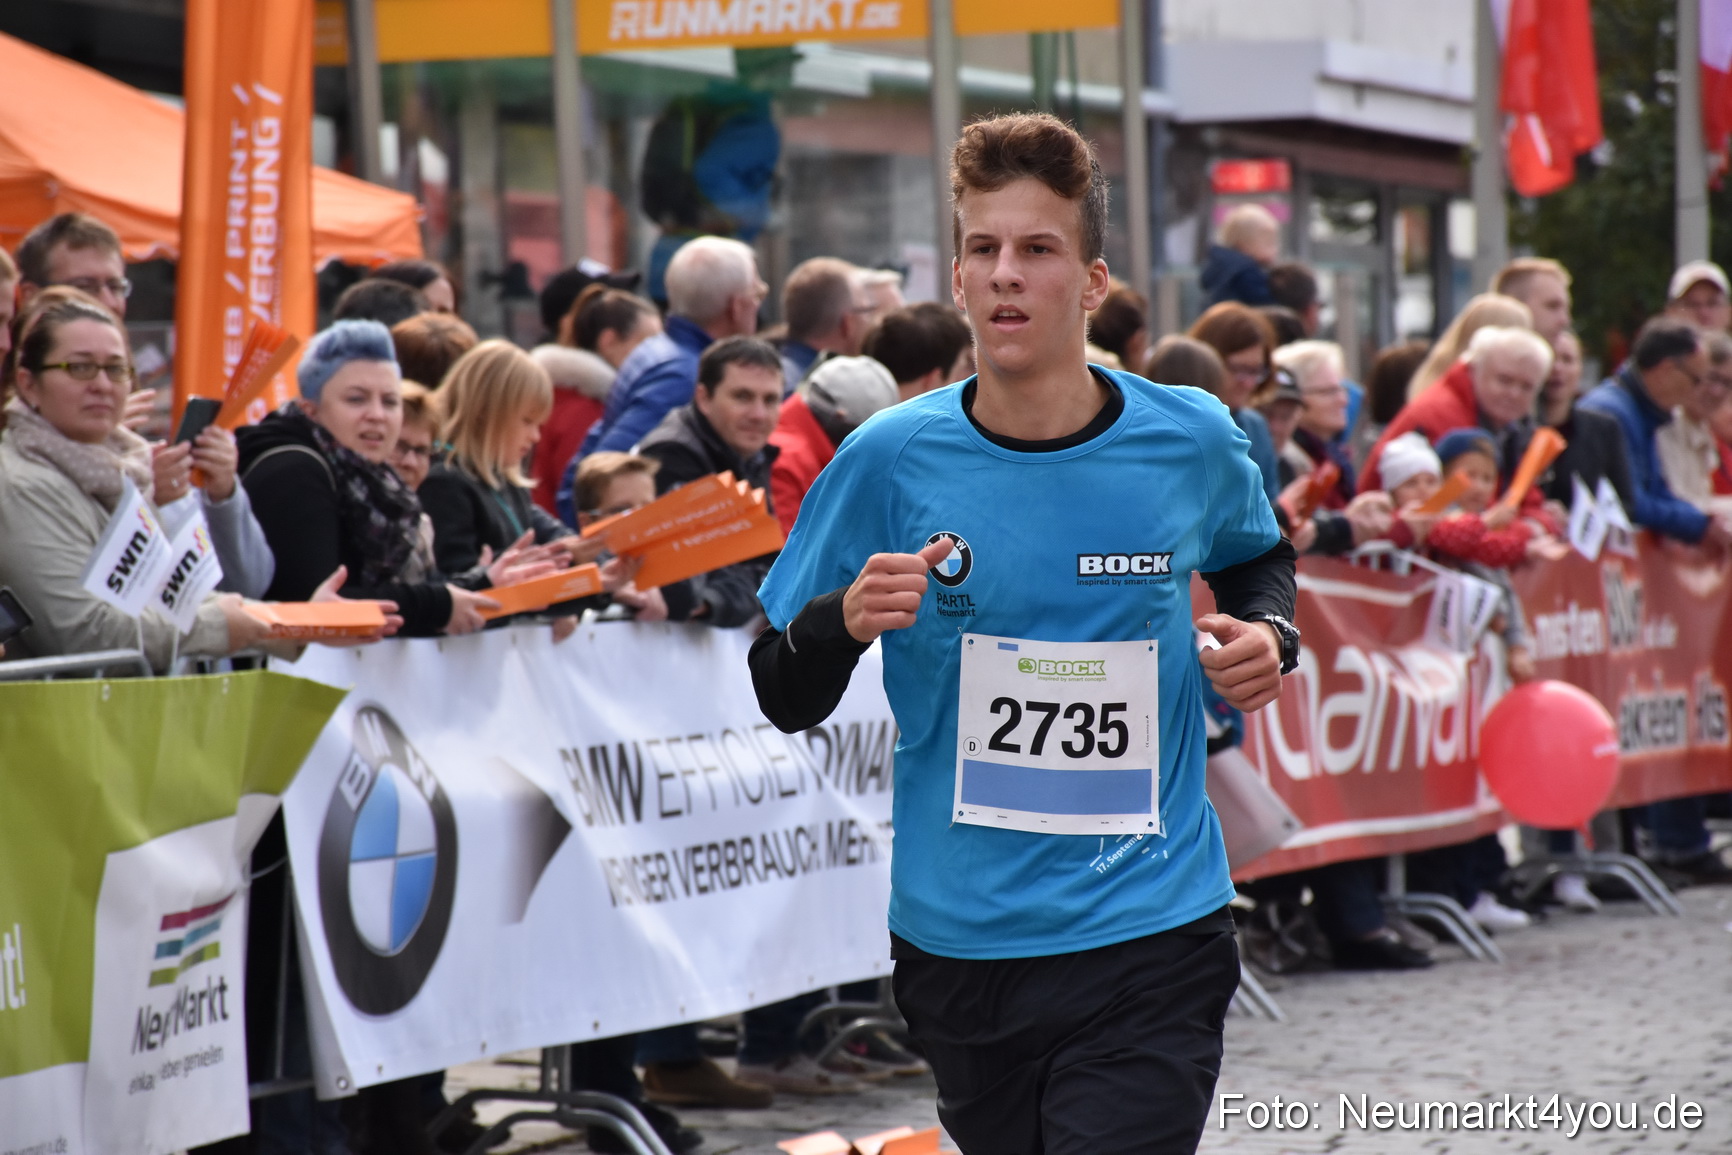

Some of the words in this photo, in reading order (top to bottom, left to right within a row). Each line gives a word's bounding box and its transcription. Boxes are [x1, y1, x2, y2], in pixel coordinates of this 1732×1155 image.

[225, 118, 248, 259] PRINT
[107, 530, 149, 594] swn
[1077, 552, 1174, 577] BOCK
[161, 550, 199, 609] swn
[1077, 578, 1109, 587] inspired
[1112, 578, 1122, 586] by
[937, 592, 976, 607] PARTL
[937, 606, 976, 617] Neumarkt
[1038, 659, 1106, 676] BOCK
[988, 696, 1129, 758] 2735
[969, 741, 976, 751] D
[1096, 862, 1110, 874] 17.
[1106, 835, 1138, 864] Septem
